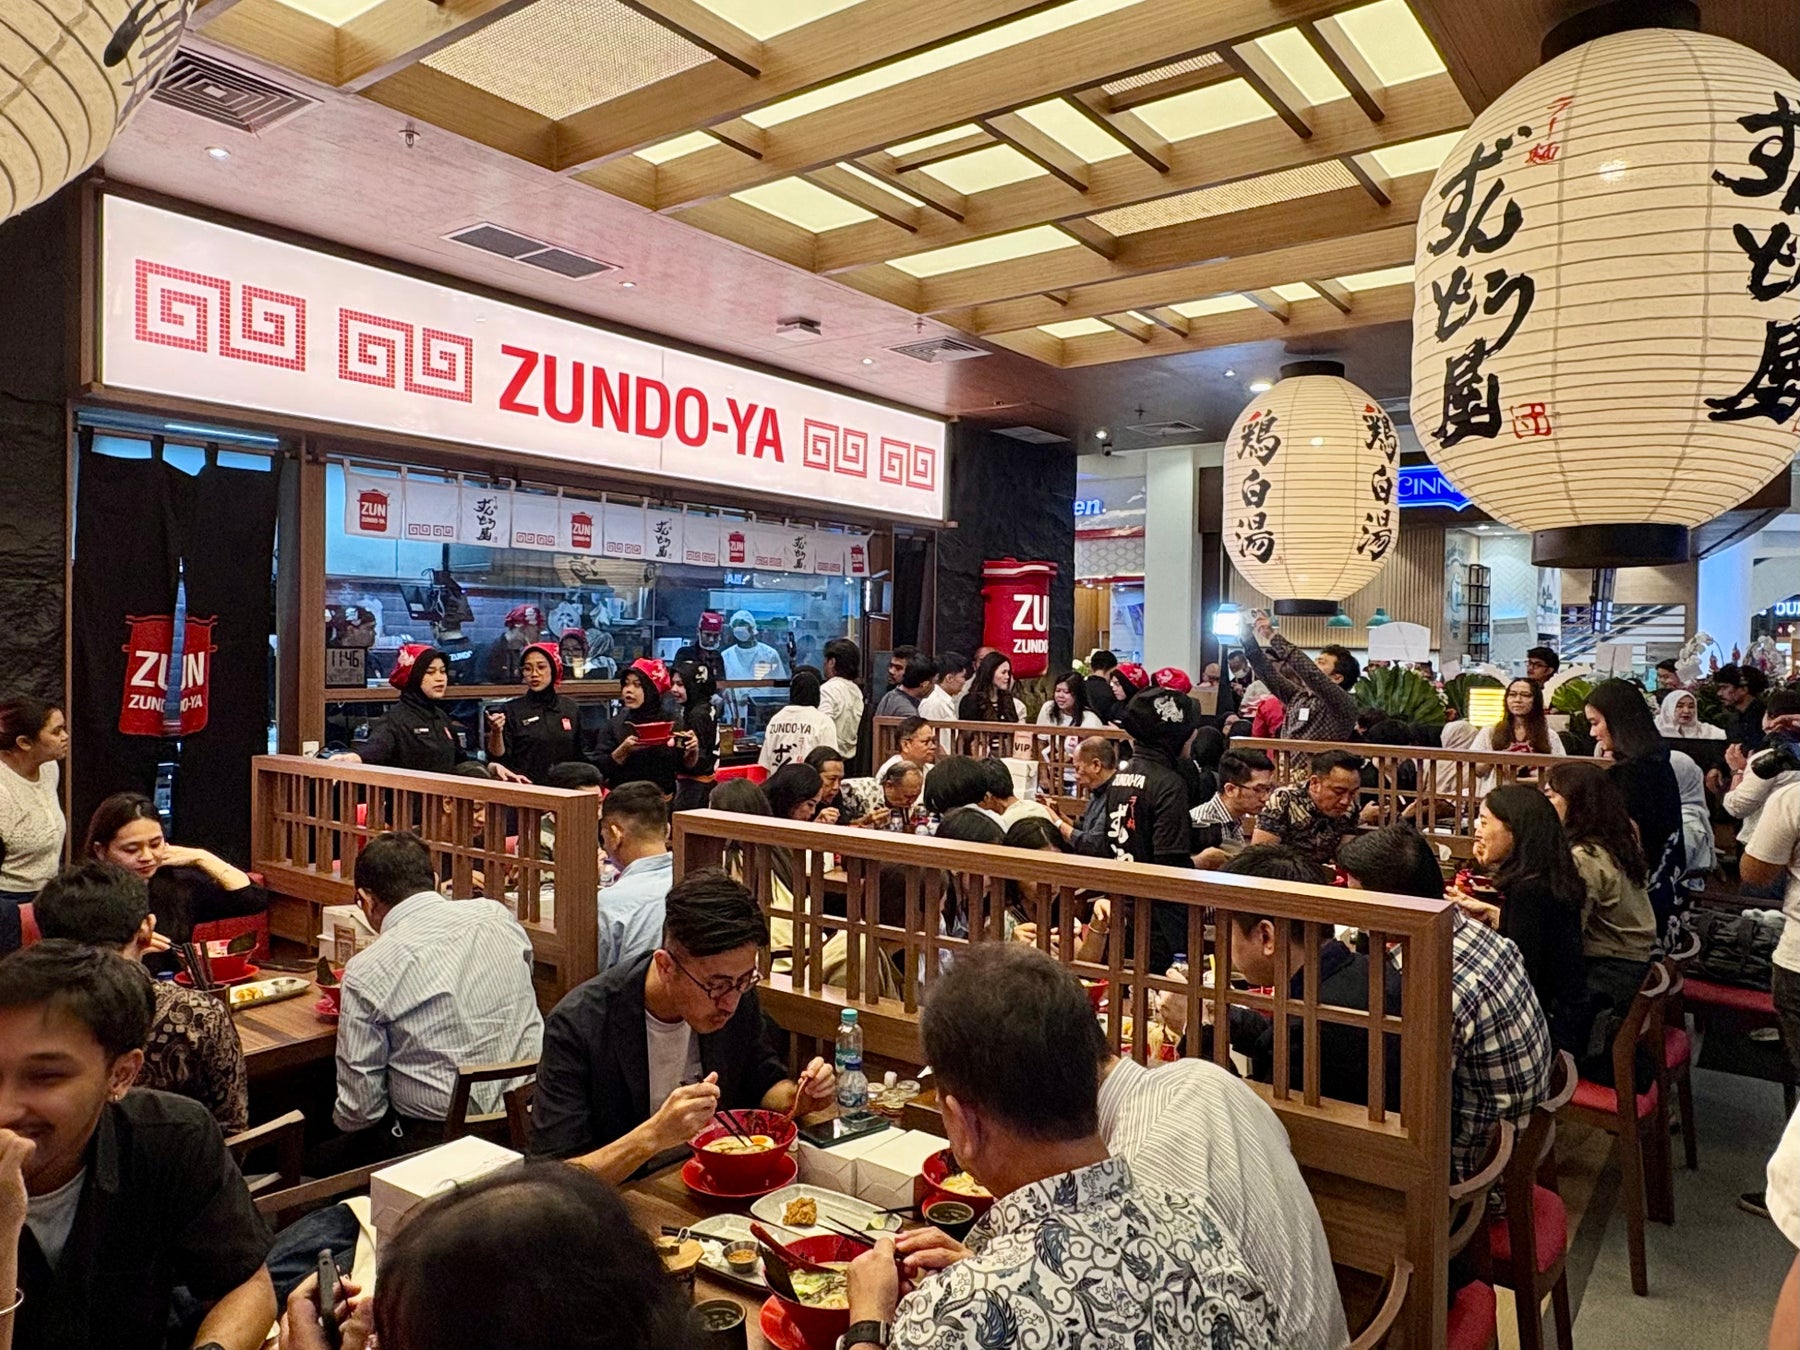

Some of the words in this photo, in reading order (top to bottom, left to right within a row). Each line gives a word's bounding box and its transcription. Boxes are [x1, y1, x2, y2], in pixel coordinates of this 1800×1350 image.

[499, 344, 784, 463] ZUNDO-YA
[361, 501, 386, 517] ZUN
[572, 522, 591, 536] ZUN
[1012, 594, 1049, 632] ZU
[769, 723, 811, 734] ZUNDO-YA
[1014, 742, 1031, 752] VIP
